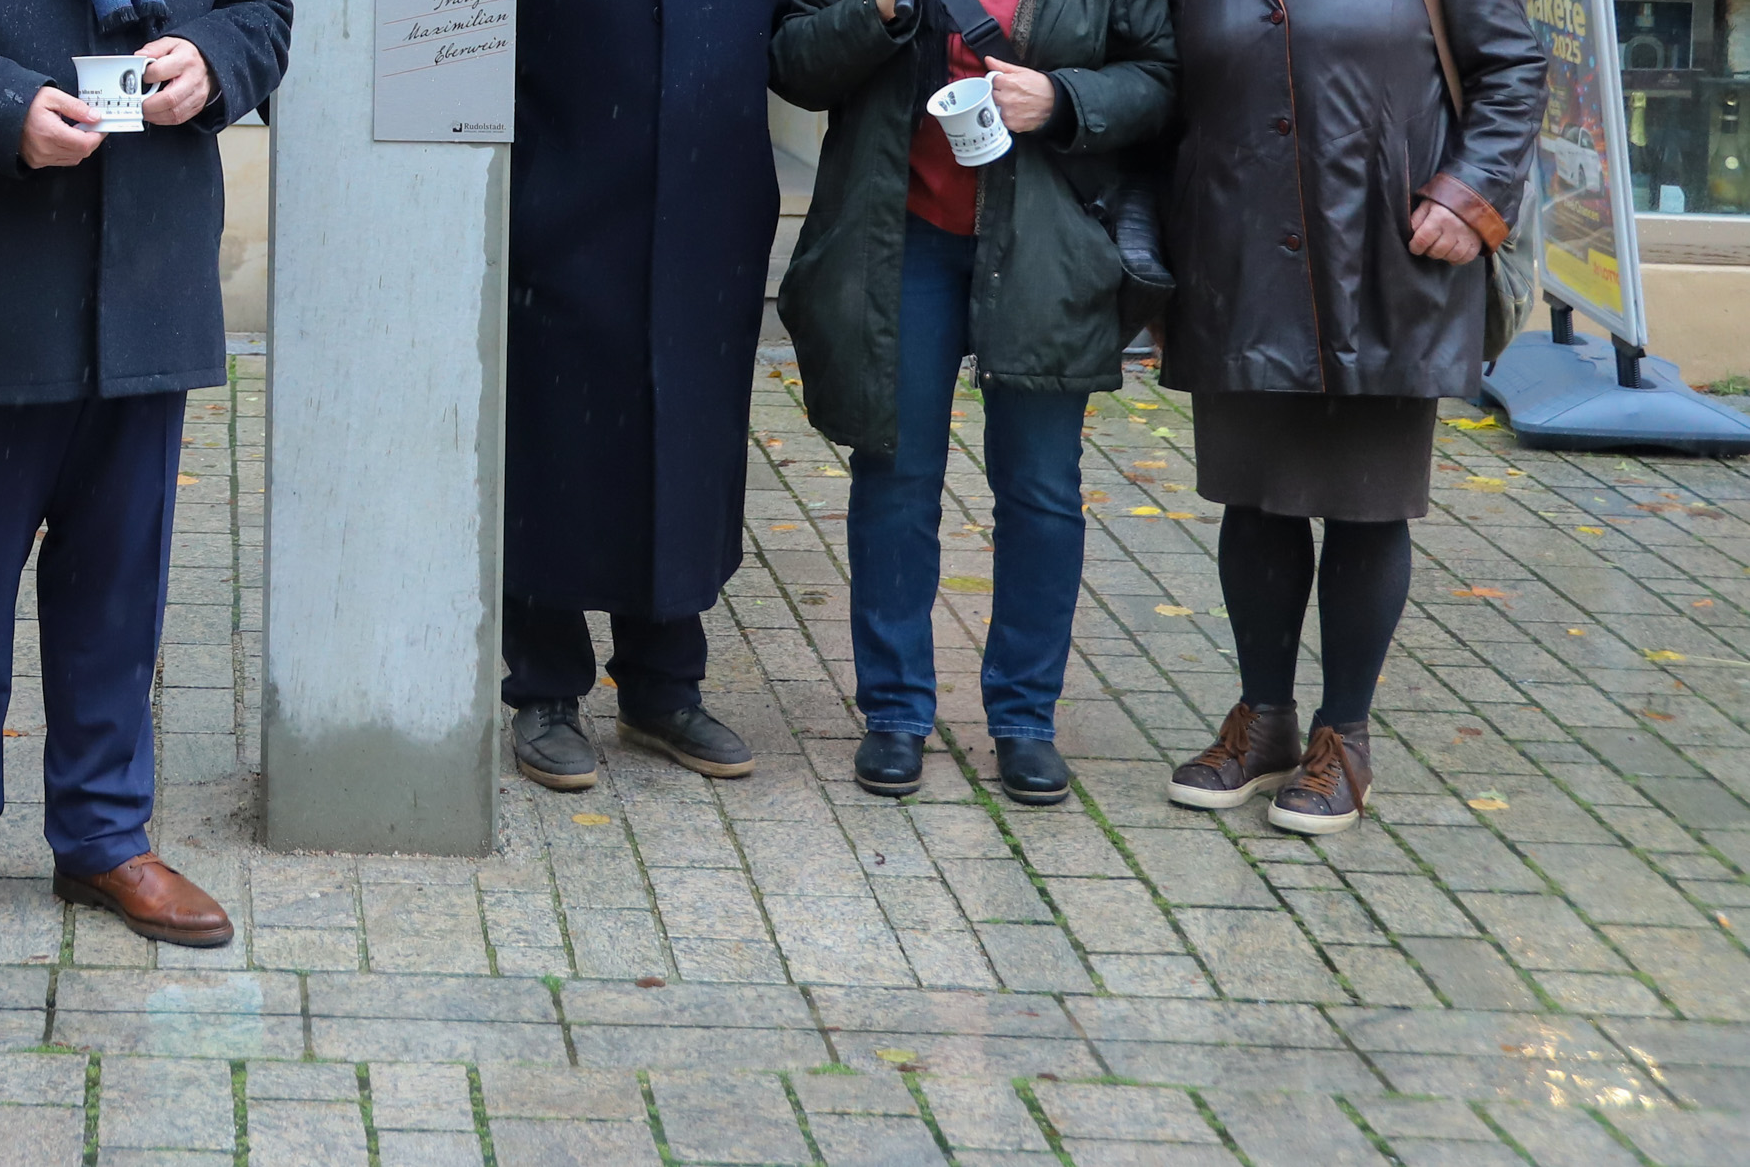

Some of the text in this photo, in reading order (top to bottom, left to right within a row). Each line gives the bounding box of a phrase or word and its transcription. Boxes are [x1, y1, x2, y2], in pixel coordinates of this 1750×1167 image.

[402, 9, 509, 41] Maximilian
[434, 37, 509, 66] Eberwein
[1552, 31, 1582, 65] 2025
